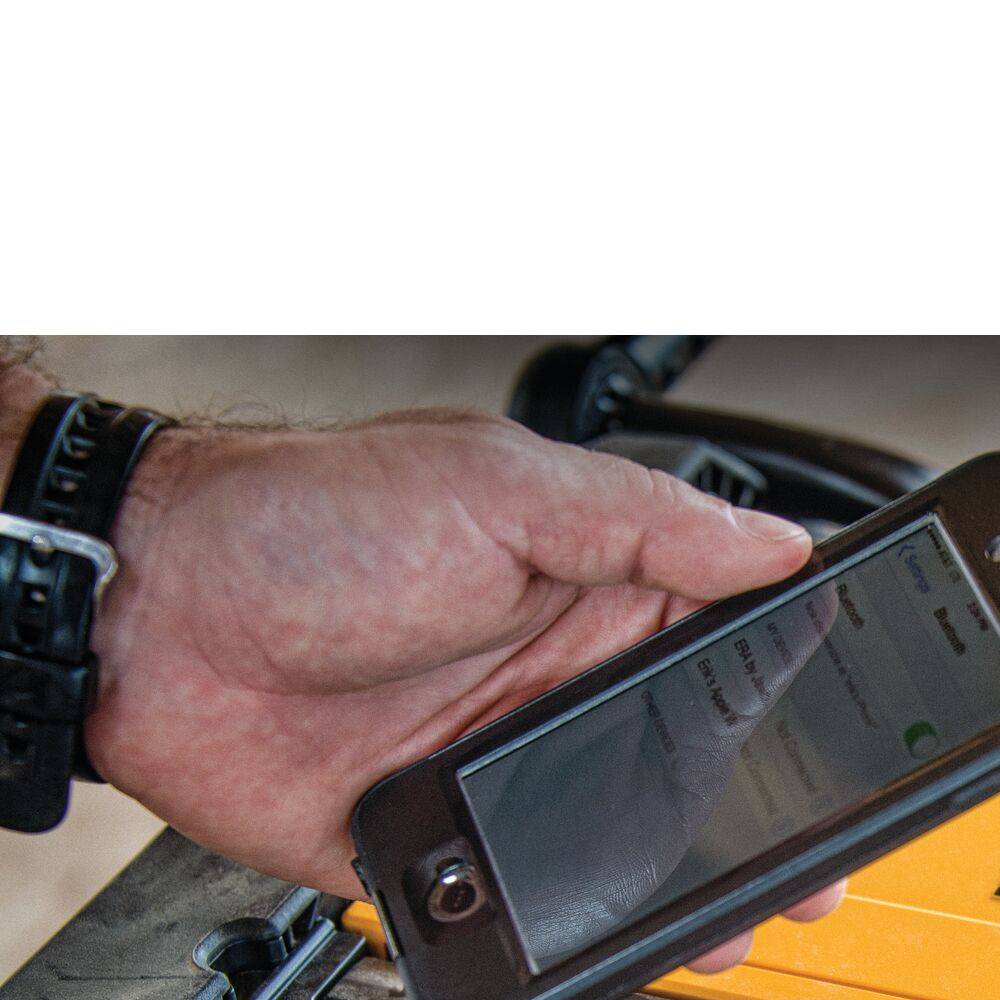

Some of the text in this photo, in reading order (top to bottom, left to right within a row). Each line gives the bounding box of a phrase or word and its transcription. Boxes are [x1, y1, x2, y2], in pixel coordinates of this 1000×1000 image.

[833, 582, 867, 631] Bluetooth
[932, 605, 969, 657] Bluetooth
[732, 637, 754, 662] ERA
[771, 634, 795, 666] DEVICE
[695, 657, 720, 687] Erik's
[741, 659, 760, 677] by
[707, 685, 733, 717] Apple
